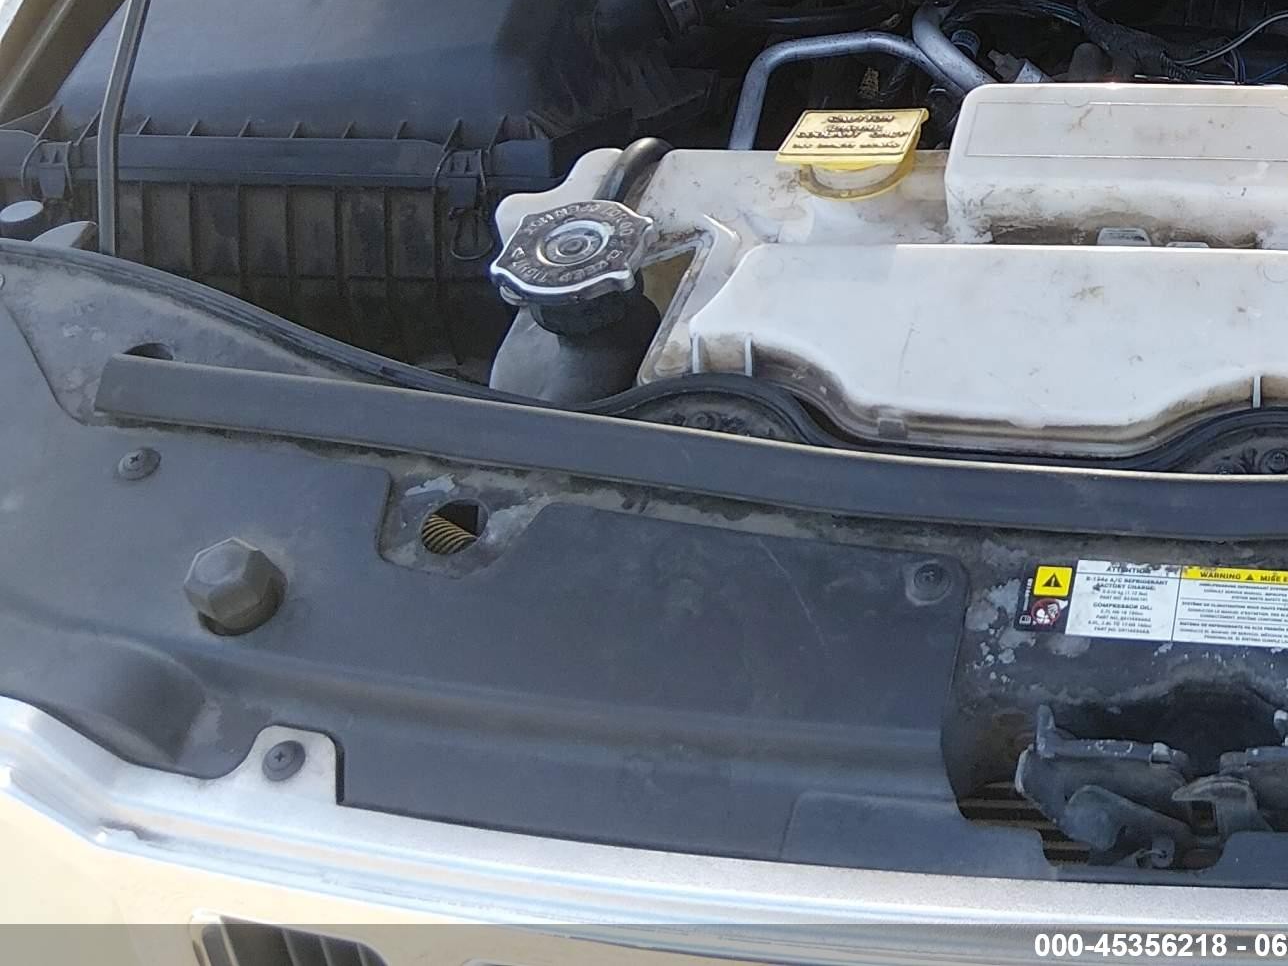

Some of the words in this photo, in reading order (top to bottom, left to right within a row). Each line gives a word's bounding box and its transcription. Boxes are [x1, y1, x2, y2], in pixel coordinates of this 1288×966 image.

[555, 203, 601, 217] OPEN
[558, 260, 609, 283] KEEP
[1200, 571, 1242, 580] WARNING
